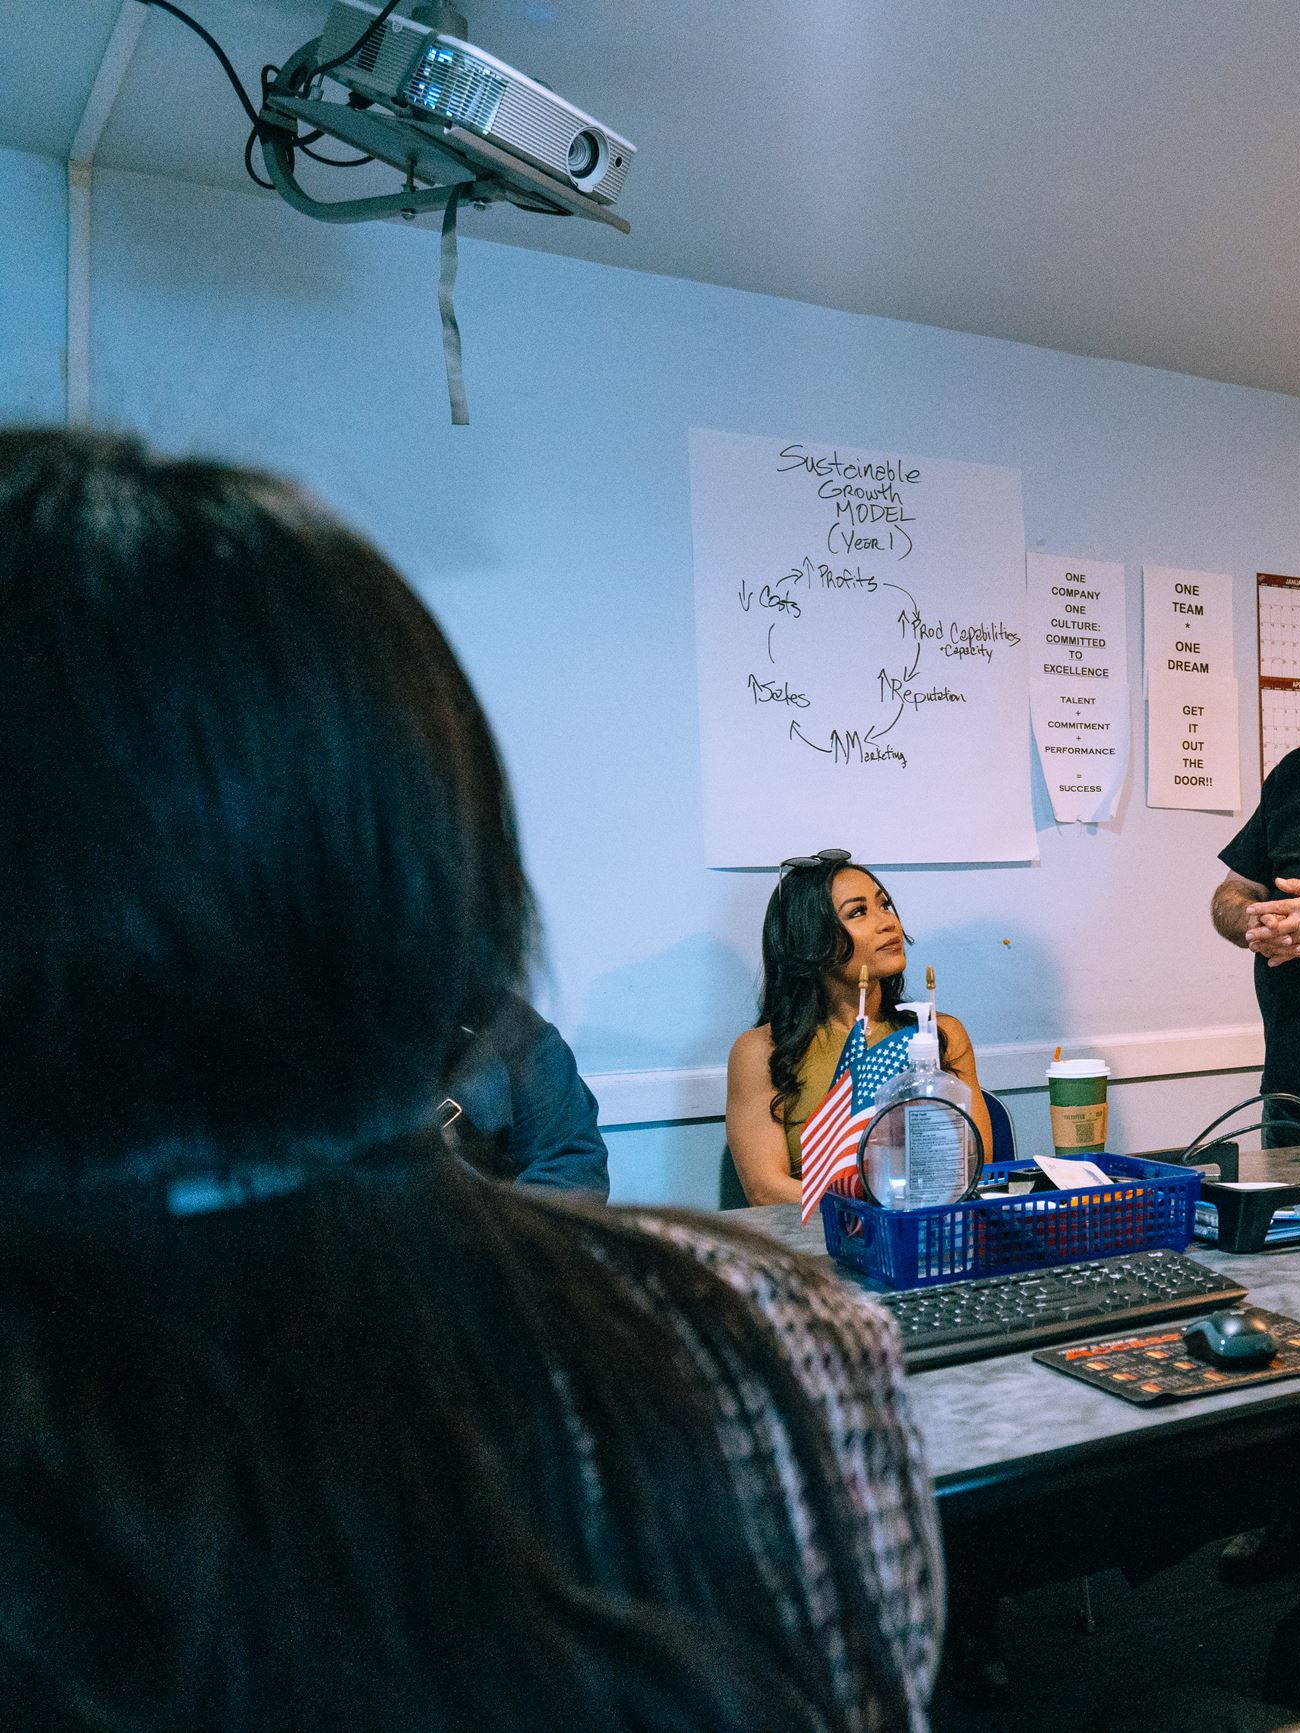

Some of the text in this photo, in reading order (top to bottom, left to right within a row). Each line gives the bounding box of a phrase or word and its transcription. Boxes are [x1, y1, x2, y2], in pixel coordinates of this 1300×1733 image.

[836, 501, 916, 525] MODEL
[1065, 573, 1086, 584] ONE
[1051, 587, 1101, 600] COMPANY
[1174, 583, 1200, 596] ONE
[1065, 604, 1086, 615] ONE
[1172, 602, 1204, 616] TEAM
[1051, 618, 1101, 632] CULTURE:
[951, 622, 1021, 648] Capabilities
[1046, 634, 1106, 648] COMMITTED
[1175, 641, 1201, 654] ONE
[1068, 650, 1083, 660] TO
[1044, 664, 1109, 678] EXCELLENCE
[1167, 660, 1209, 674] DREAM
[892, 678, 966, 711] Reputation
[1060, 696, 1096, 705] TALENT
[1182, 706, 1204, 717] GET
[1047, 721, 1110, 731] COMMITMENT
[1188, 724, 1198, 734] IT
[1044, 746, 1116, 756] PERFORMANCE
[1182, 741, 1204, 752] OUT
[1182, 758, 1204, 769] THE
[1174, 775, 1213, 787] DOOR!!
[1059, 784, 1102, 793] SUCCESS
